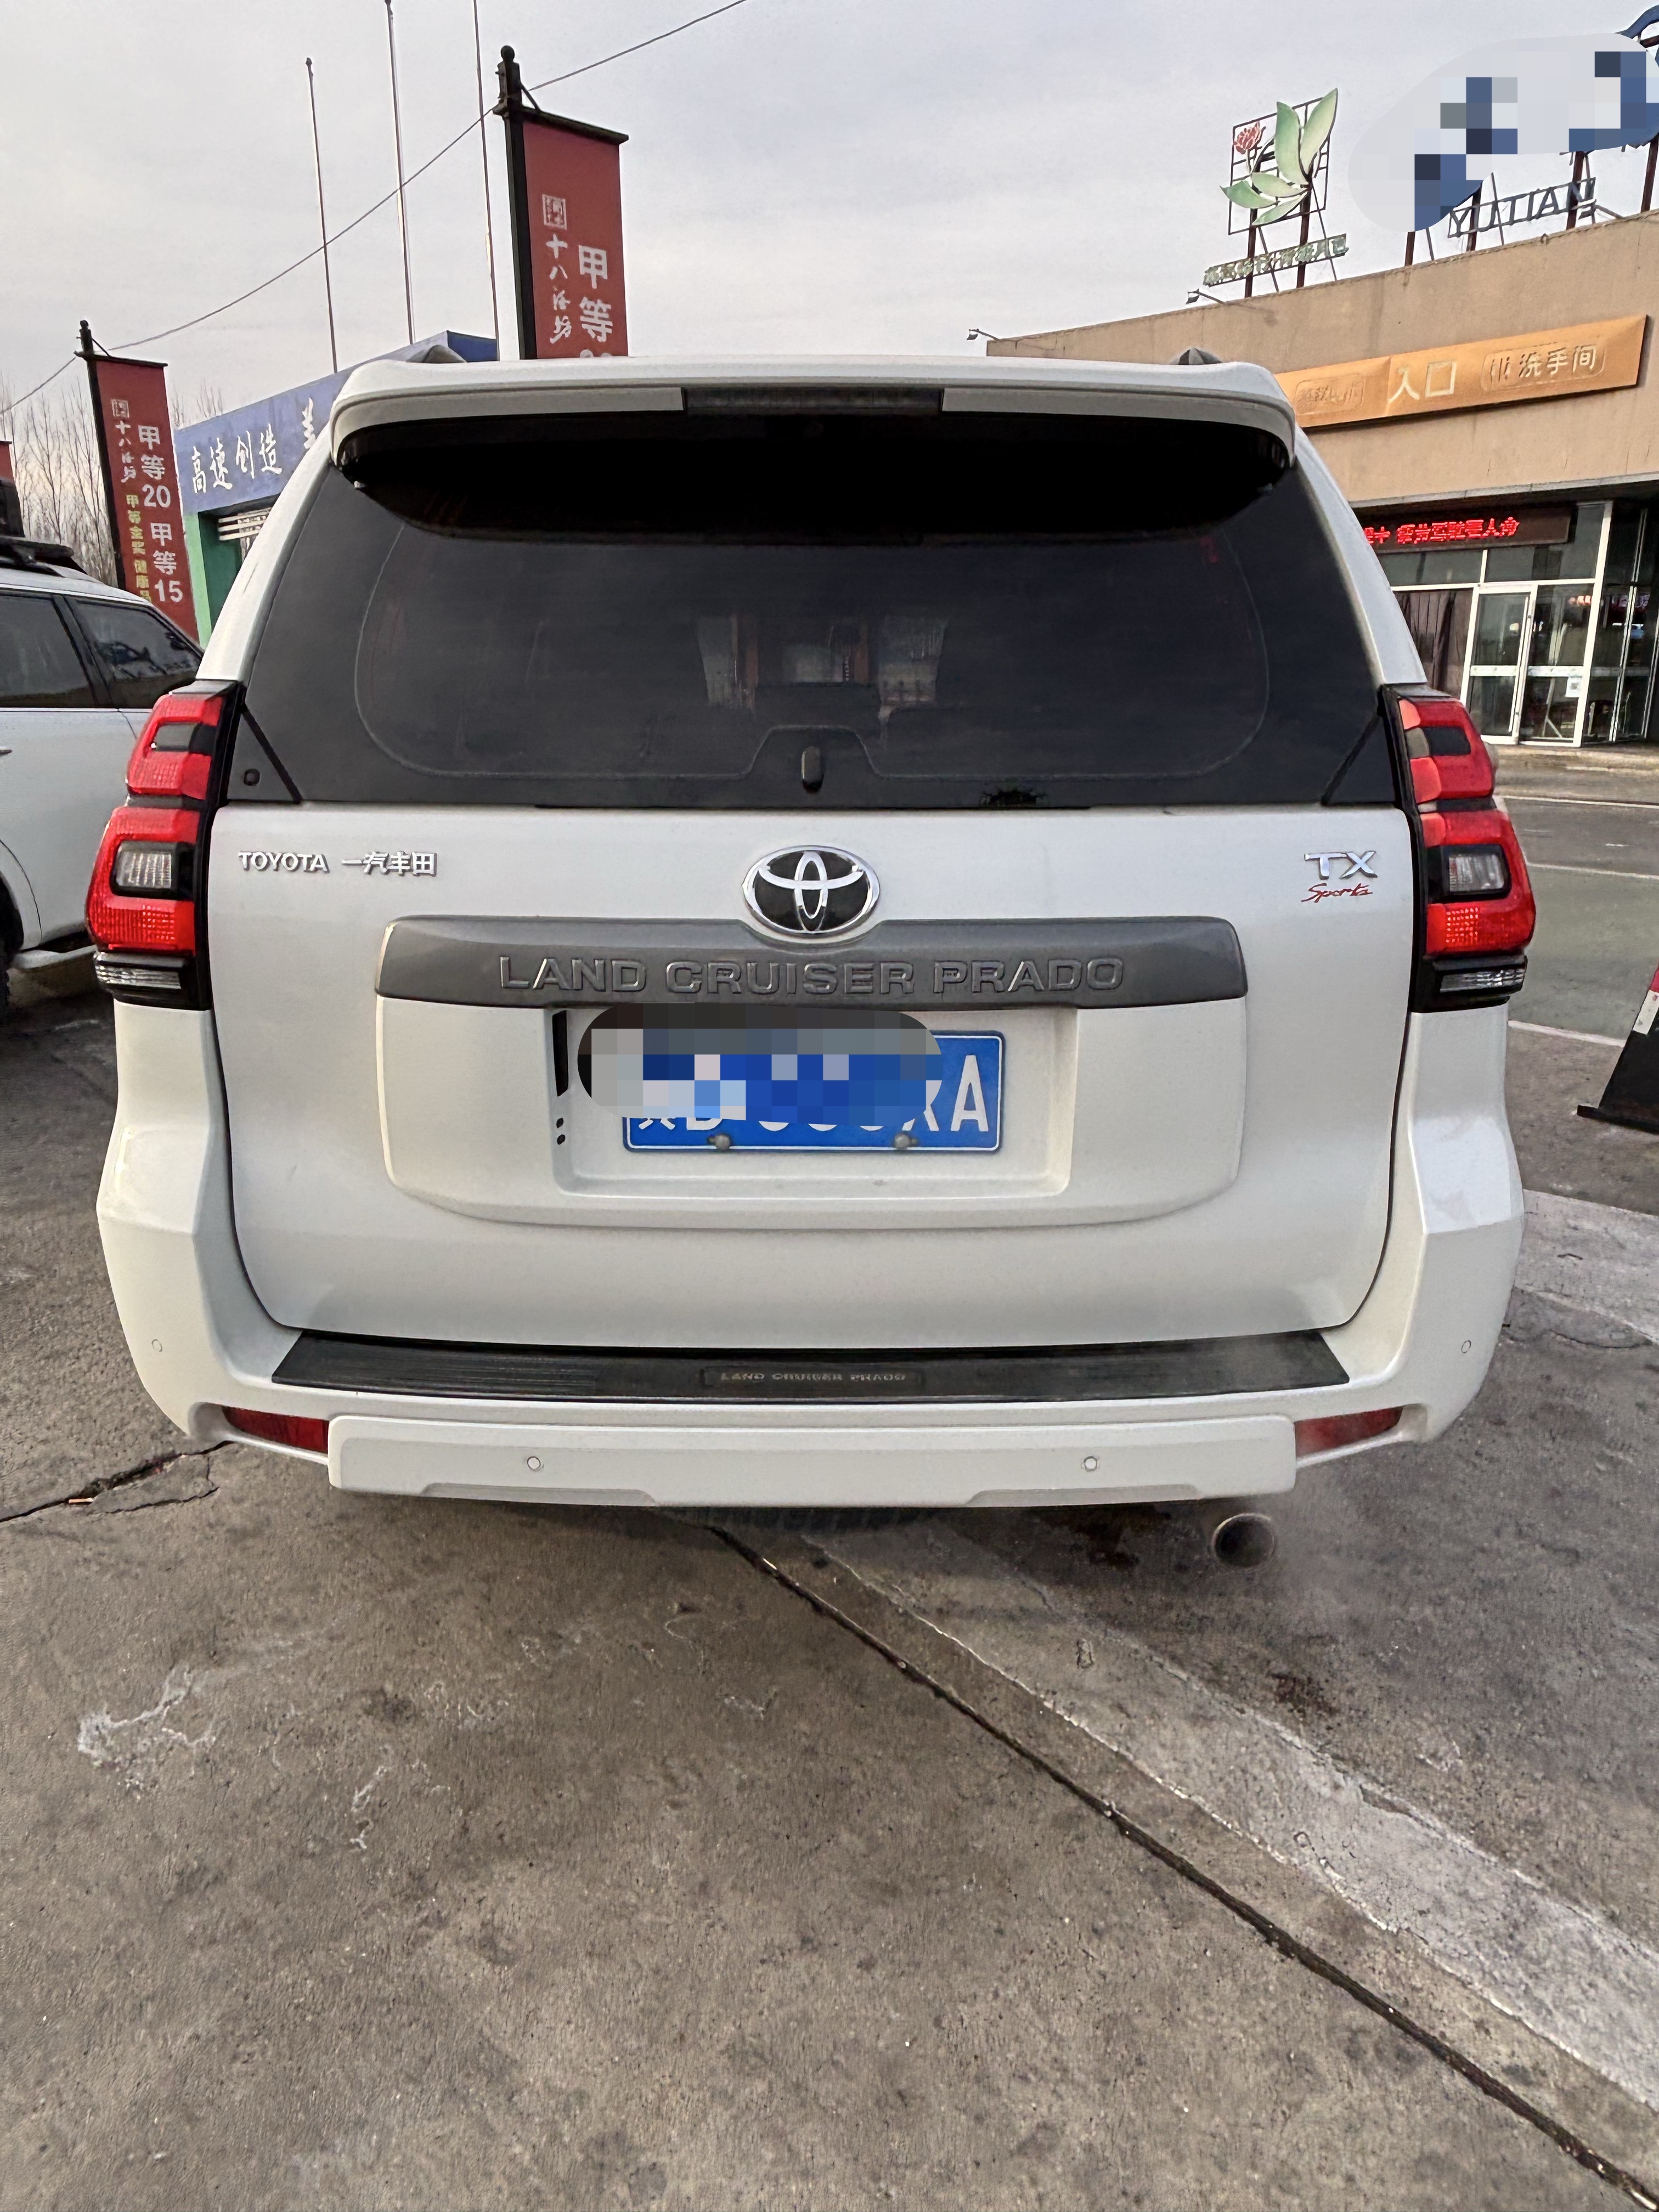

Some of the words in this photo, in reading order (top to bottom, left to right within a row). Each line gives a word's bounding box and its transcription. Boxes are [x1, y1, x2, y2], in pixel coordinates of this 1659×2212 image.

[578, 244, 613, 358] 甲等
[1519, 344, 1597, 378] 洗手间
[1387, 360, 1457, 405] 入口
[138, 425, 171, 508] 甲等20
[150, 522, 183, 602] 甲等15
[238, 851, 330, 873] TOYOTA
[341, 850, 437, 877] 一汽丰田
[1304, 850, 1378, 880] TX
[1301, 883, 1373, 903] Sports
[499, 955, 647, 992] LAND
[664, 959, 916, 997] CRUISER
[932, 956, 1125, 994] PRADO
